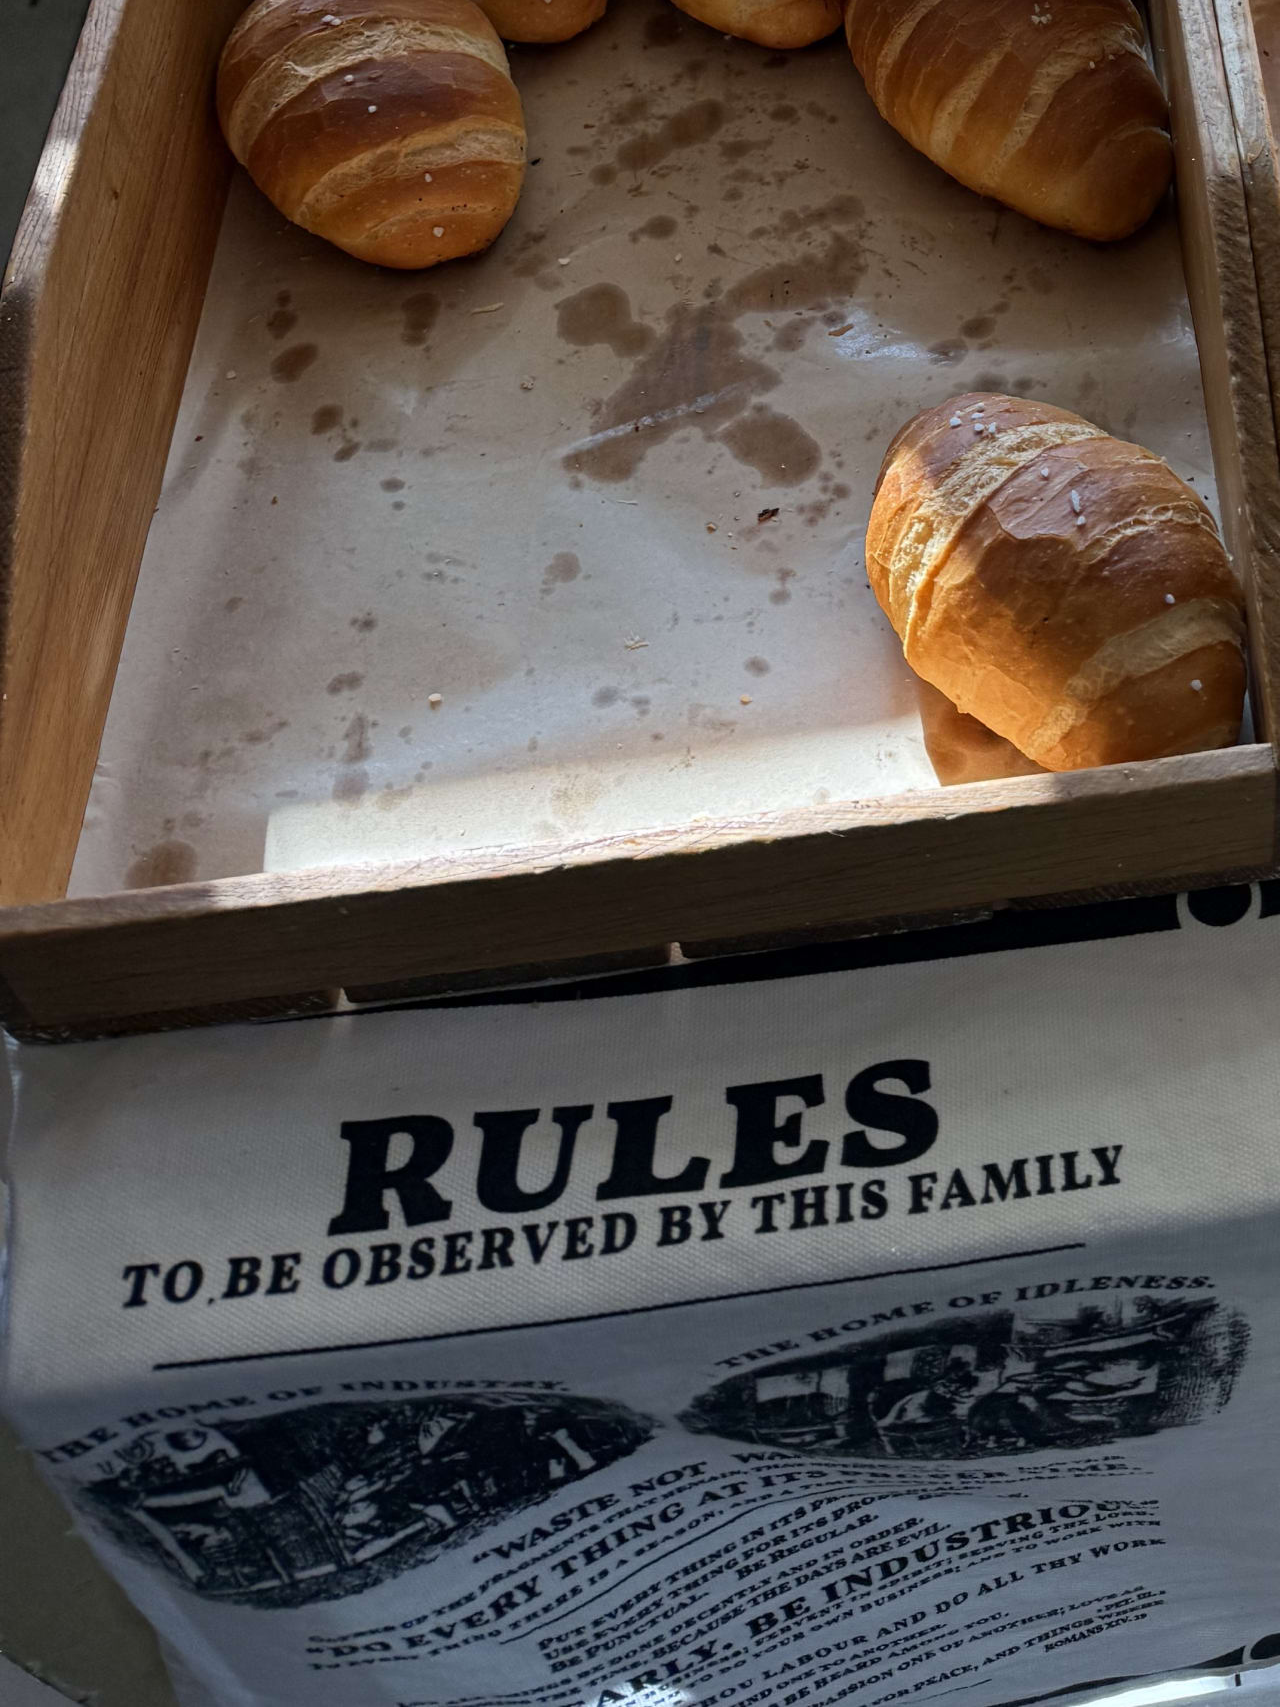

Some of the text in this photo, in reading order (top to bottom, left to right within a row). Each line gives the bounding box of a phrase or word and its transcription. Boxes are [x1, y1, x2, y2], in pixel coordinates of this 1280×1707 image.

[327, 1058, 940, 1236] RULES
[122, 1144, 1125, 1309] TO BE OBSERVED BY THIS FAMILY
[714, 1274, 1217, 1371] THE HOME OF IDLENESS.
[118, 1396, 256, 1428] HOME
[267, 1385, 323, 1402] OF
[628, 1461, 708, 1497] NOT
[401, 1574, 545, 1650] EVERY
[551, 1501, 686, 1580] THING
[696, 1481, 749, 1507] AT
[663, 1542, 739, 1586] THING
[734, 1558, 767, 1581] BE
[768, 1512, 881, 1564] REGULAR.
[740, 1537, 788, 1563] FOR
[789, 1516, 829, 1540] ITS
[749, 1581, 794, 1607] THE
[794, 1557, 849, 1588] DAYS
[849, 1543, 894, 1566] ARE
[745, 1596, 812, 1638] BE
[761, 1537, 1168, 1682] LABOUR AND DO ALL THY WORK
